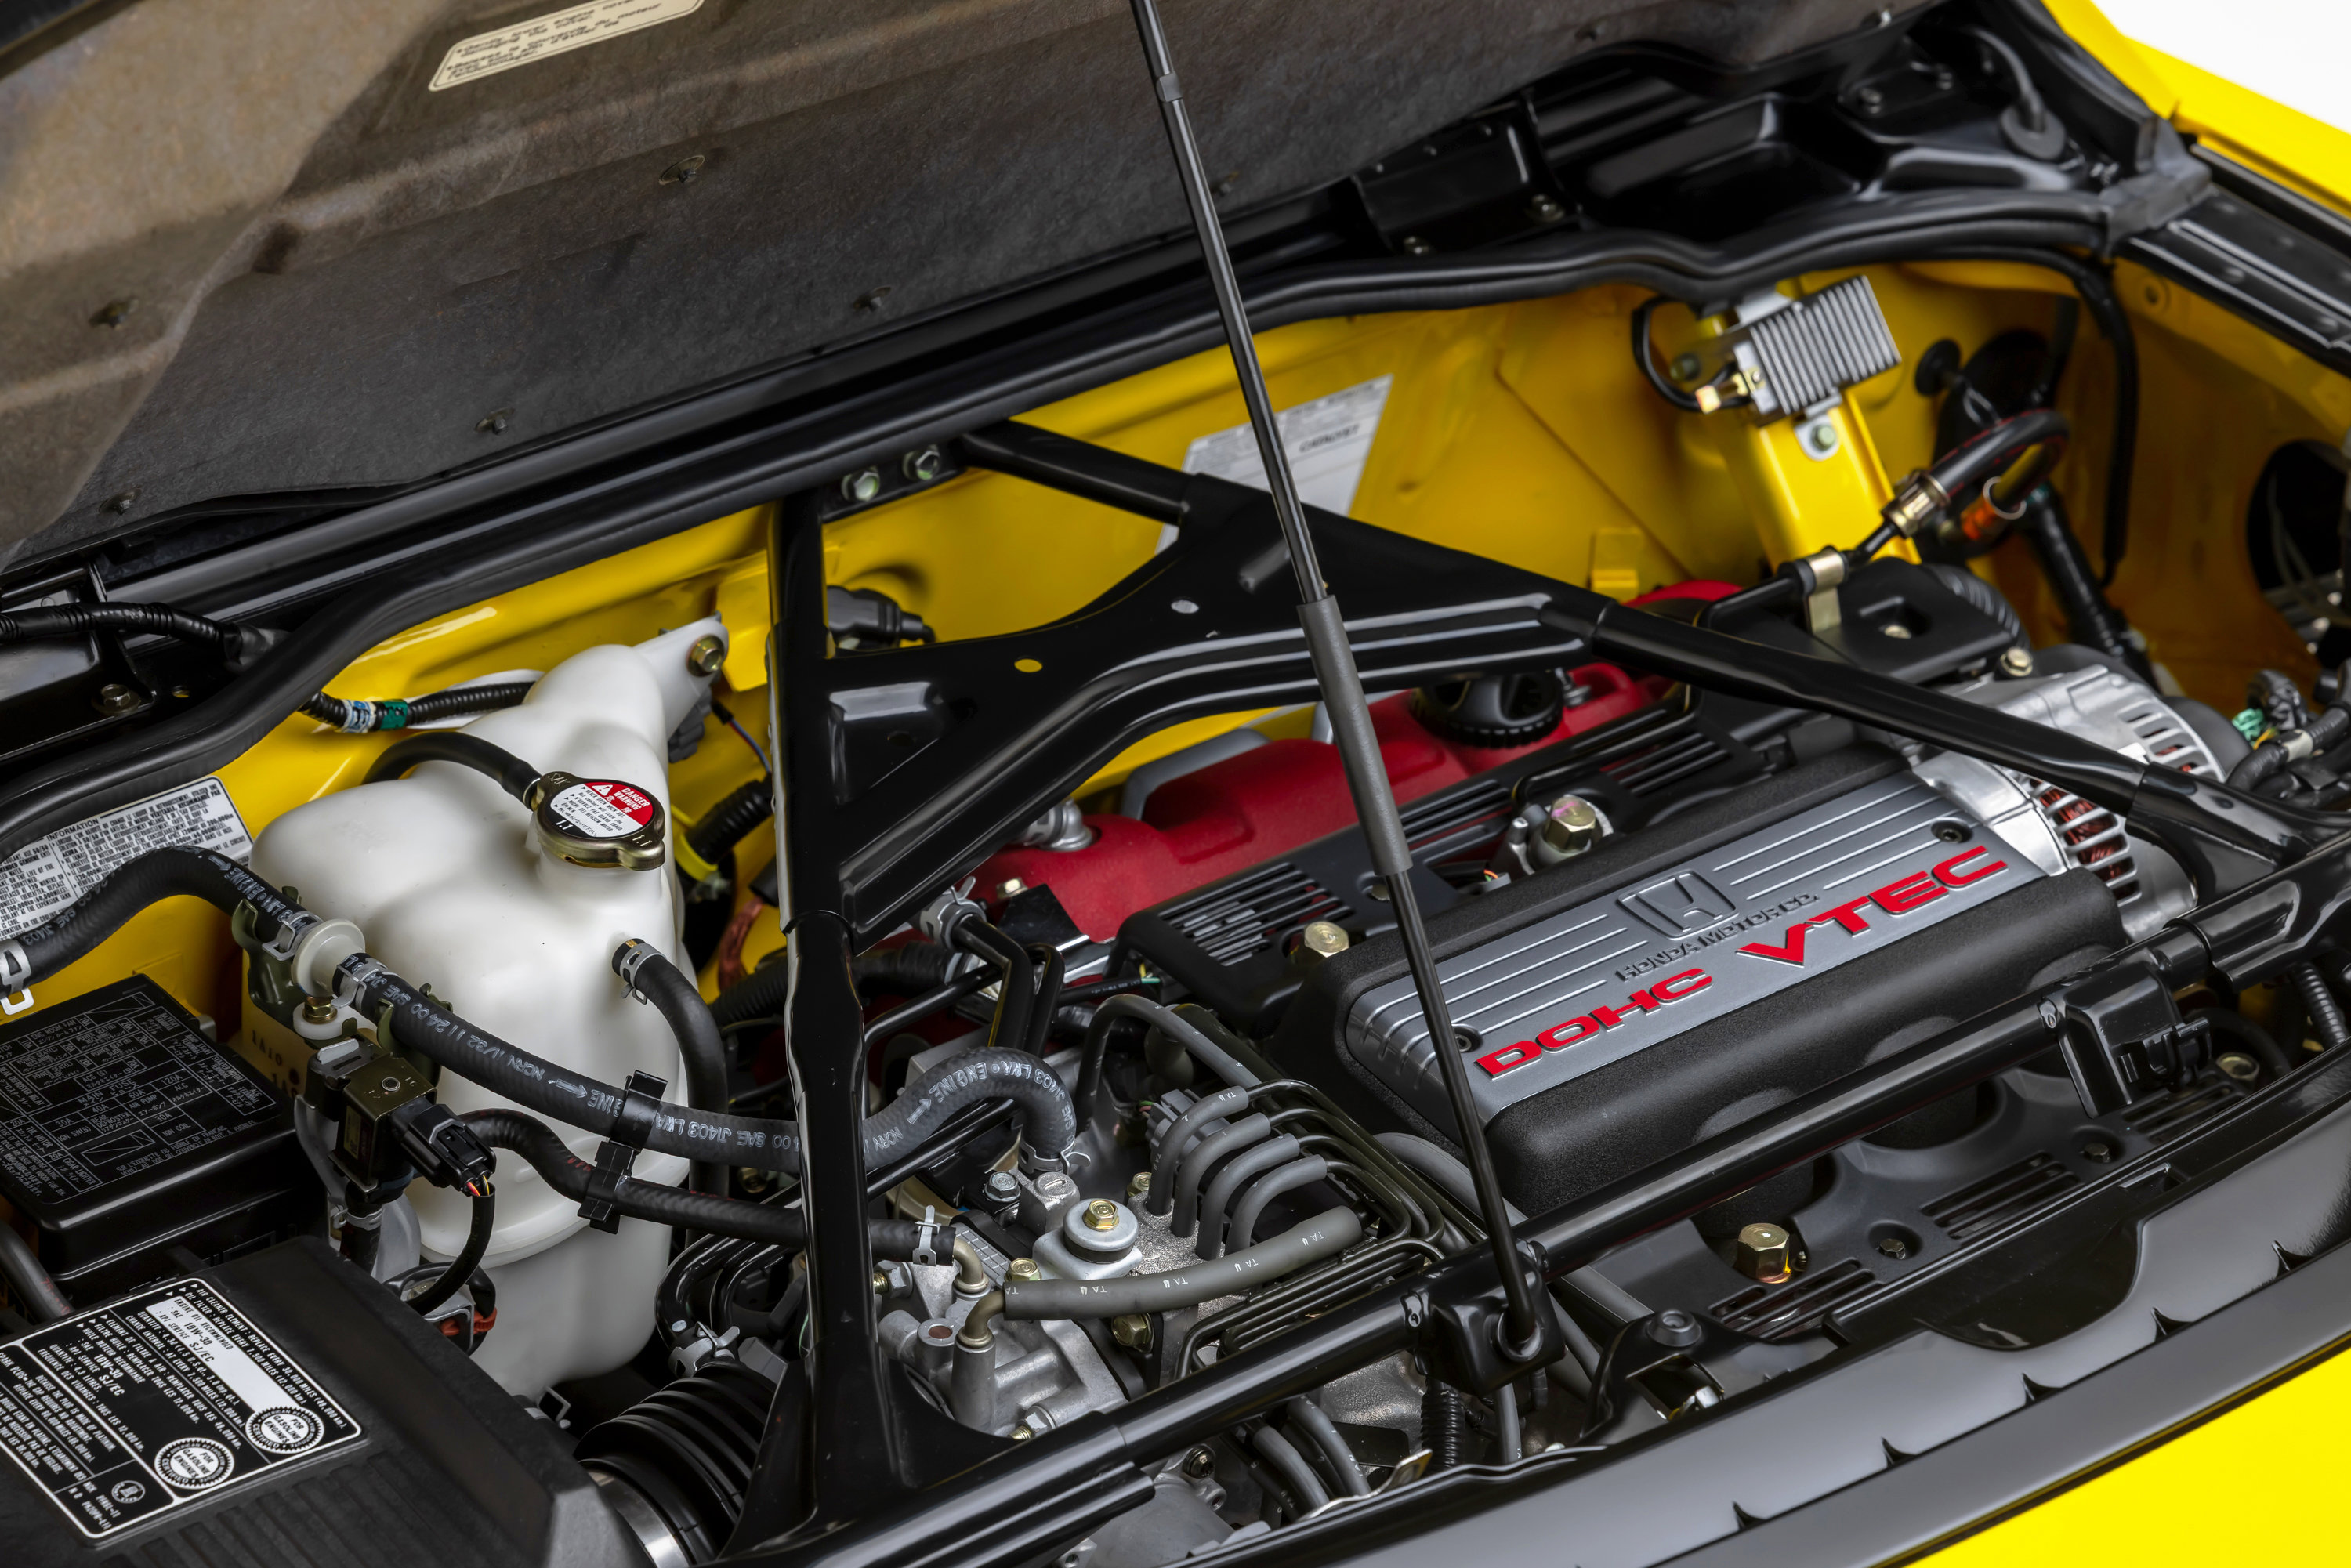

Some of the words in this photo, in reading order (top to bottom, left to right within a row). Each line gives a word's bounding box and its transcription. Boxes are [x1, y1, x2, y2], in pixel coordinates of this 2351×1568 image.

[613, 790, 642, 811] WARNUNG
[621, 787, 650, 807] DANGER
[555, 818, 573, 831] 1.1
[567, 799, 580, 808] NICHT
[600, 822, 613, 831] MOTOR
[597, 813, 611, 823] QUAND
[47, 818, 99, 841] INFORMATION
[632, 834, 653, 846] 1.1
[32, 844, 49, 853] 50/50
[1615, 942, 1698, 982] HONDA
[1697, 907, 1782, 948] MOTOR
[1780, 893, 1820, 915] CO.
[1475, 968, 1713, 1079] DOHC
[1735, 846, 2009, 968] VTEC
[43, 1025, 63, 1034] ROOM
[160, 1074, 183, 1085] 120A
[507, 1056, 546, 1081] NCRN
[76, 1090, 104, 1103] MAIN
[107, 1078, 136, 1091] FUSE
[172, 1082, 189, 1091] ACG
[928, 1061, 988, 1103] ENGINE
[126, 1088, 147, 1099] 60A
[139, 1094, 159, 1104] PUMP
[90, 1103, 109, 1113] 40A
[90, 1114, 108, 1124] REAR
[154, 1111, 173, 1122] 30A
[54, 1117, 74, 1127] 30A
[94, 1111, 131, 1128] DEFROSTER
[173, 1121, 191, 1132] COIL
[687, 1121, 731, 1143] J1403
[737, 1130, 766, 1148] SAE
[61, 1157, 78, 1169] CIGAR
[74, 1168, 96, 1185] LIGHTER
[136, 1310, 162, 1331] QUANTITY
[169, 1309, 183, 1318] SAE
[183, 1321, 213, 1345] 10W-30
[173, 1298, 194, 1313] ENGINE
[199, 1321, 234, 1350] RECOMMENDED
[158, 1313, 171, 1322] API
[167, 1322, 190, 1339] SERVICE
[187, 1341, 215, 1362] SJ/EC
[183, 1291, 197, 1300] OIL
[192, 1299, 213, 1314] FILTER
[211, 1316, 235, 1334] REPLACE
[230, 1334, 250, 1348] EVERY
[259, 1361, 280, 1376] MILES
[195, 1287, 209, 1296] AIR
[205, 1296, 229, 1314] CLEANER
[223, 1313, 248, 1331] ELEMENT
[246, 1334, 271, 1353] REPLACE
[266, 1352, 286, 1366] EVERY
[298, 1382, 319, 1398] MILES
[81, 1327, 100, 1340] HUILE
[94, 1339, 117, 1356] MOTEUR
[111, 1356, 147, 1384] RECOMMANDE
[92, 1323, 113, 1338] FILTRE
[108, 1337, 127, 1350] HUILE
[125, 1352, 155, 1376] REMPLACER
[124, 1315, 146, 1331] CHANGE
[141, 1330, 166, 1349] INTERVAL
[171, 1358, 190, 1372] EVERY
[198, 1385, 219, 1400] MILES
[77, 1354, 101, 1372] SERVICE
[96, 1374, 126, 1396] SJ/EC
[92, 1353, 125, 1378] 10W-30
[105, 1319, 129, 1337] ELEMENT
[131, 1342, 152, 1358] FILTRE
[153, 1363, 167, 1372] AIR
[165, 1374, 195, 1399] REMPLACER
[190, 1399, 208, 1411] TOUS
[202, 1411, 218, 1421] LES
[70, 1379, 96, 1401] VIDANGES
[263, 1420, 291, 1443] ENGINES
[271, 1414, 302, 1439] GASOLINE
[289, 1418, 305, 1429] FOR
[172, 1454, 201, 1478] ENGINES
[181, 1449, 211, 1474] GASOLINE
[199, 1452, 215, 1463] FOR
